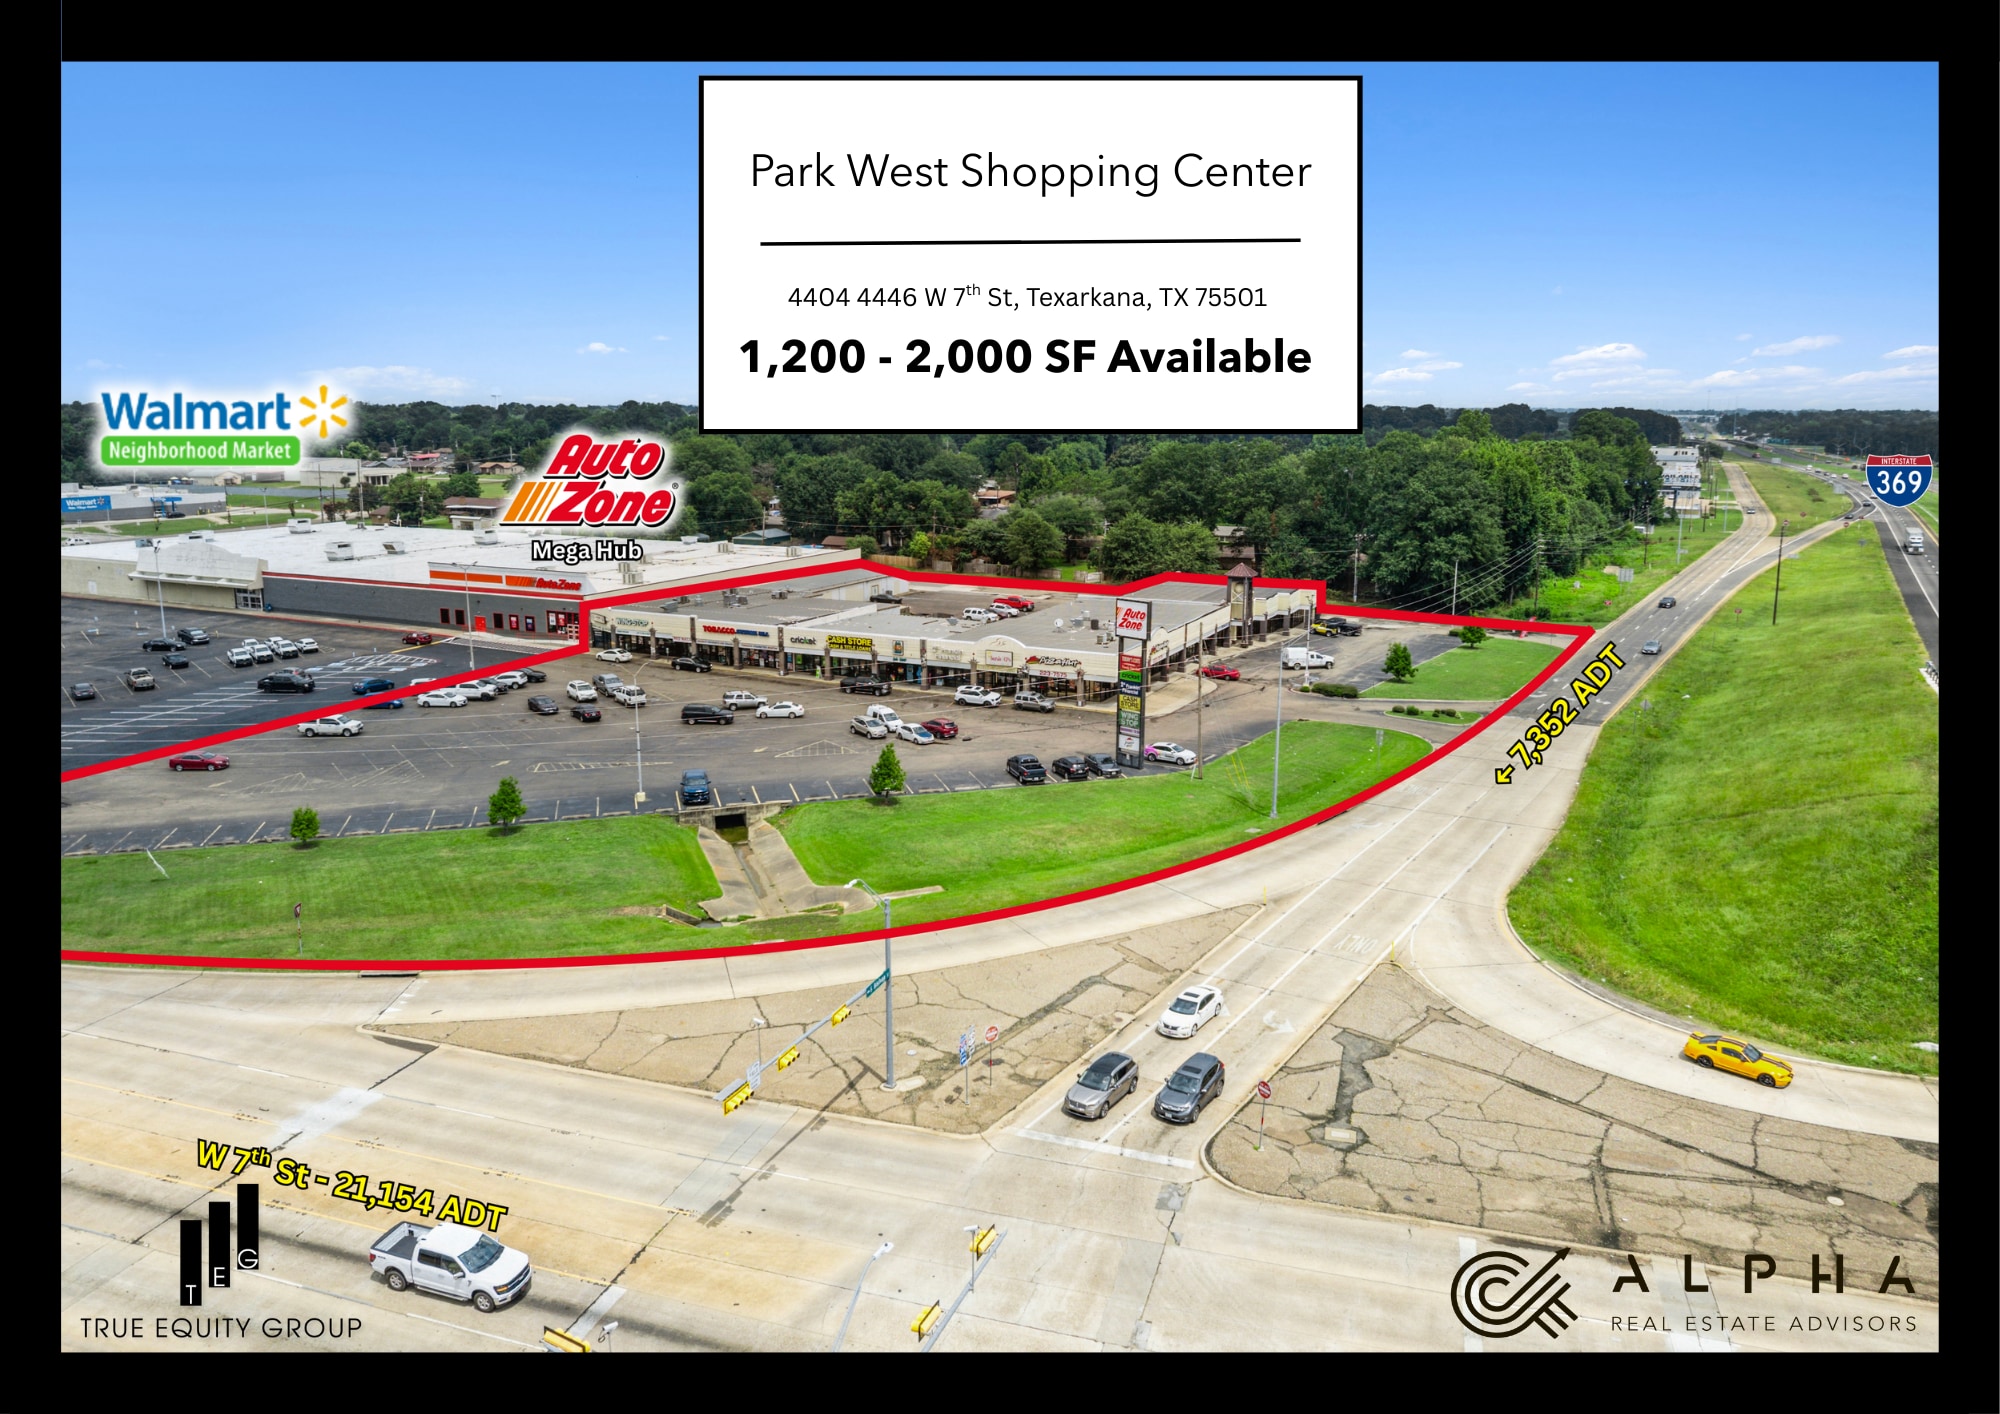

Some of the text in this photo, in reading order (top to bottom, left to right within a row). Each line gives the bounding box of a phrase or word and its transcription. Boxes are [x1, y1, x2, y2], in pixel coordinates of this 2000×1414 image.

[65, 498, 97, 507] Walmart
[1123, 607, 1147, 621] Auto
[1118, 617, 1144, 630] Zone
[702, 624, 736, 635] TOBACCO
[790, 635, 817, 645] cricket
[826, 634, 872, 647] CASH STORE
[1122, 695, 1138, 703] CASH
[1120, 700, 1140, 709] STORE
[1120, 711, 1139, 721] WING
[1119, 719, 1139, 728] STOP
